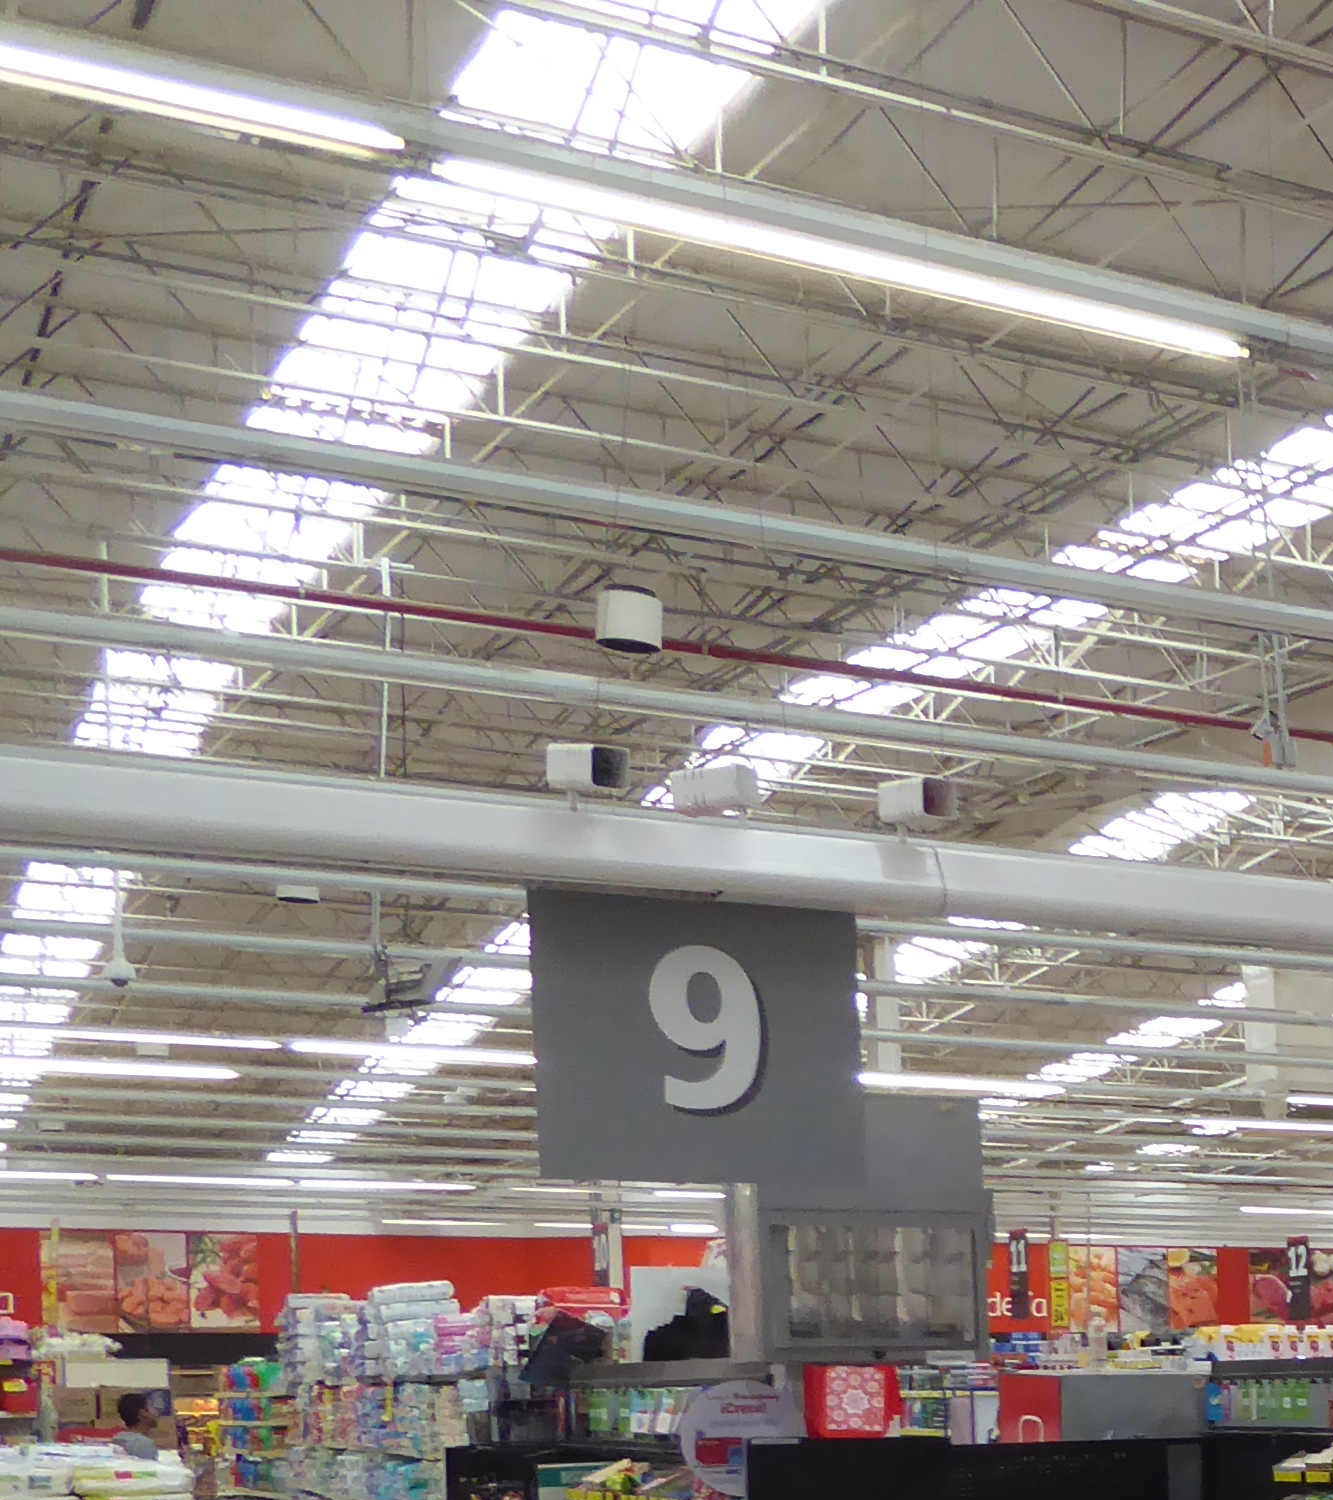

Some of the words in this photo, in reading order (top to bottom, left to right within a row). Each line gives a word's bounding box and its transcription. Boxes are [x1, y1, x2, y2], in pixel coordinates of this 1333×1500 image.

[648, 944, 765, 1113] 9
[1010, 1239, 1027, 1273] 11
[1288, 1244, 1308, 1277] 12
